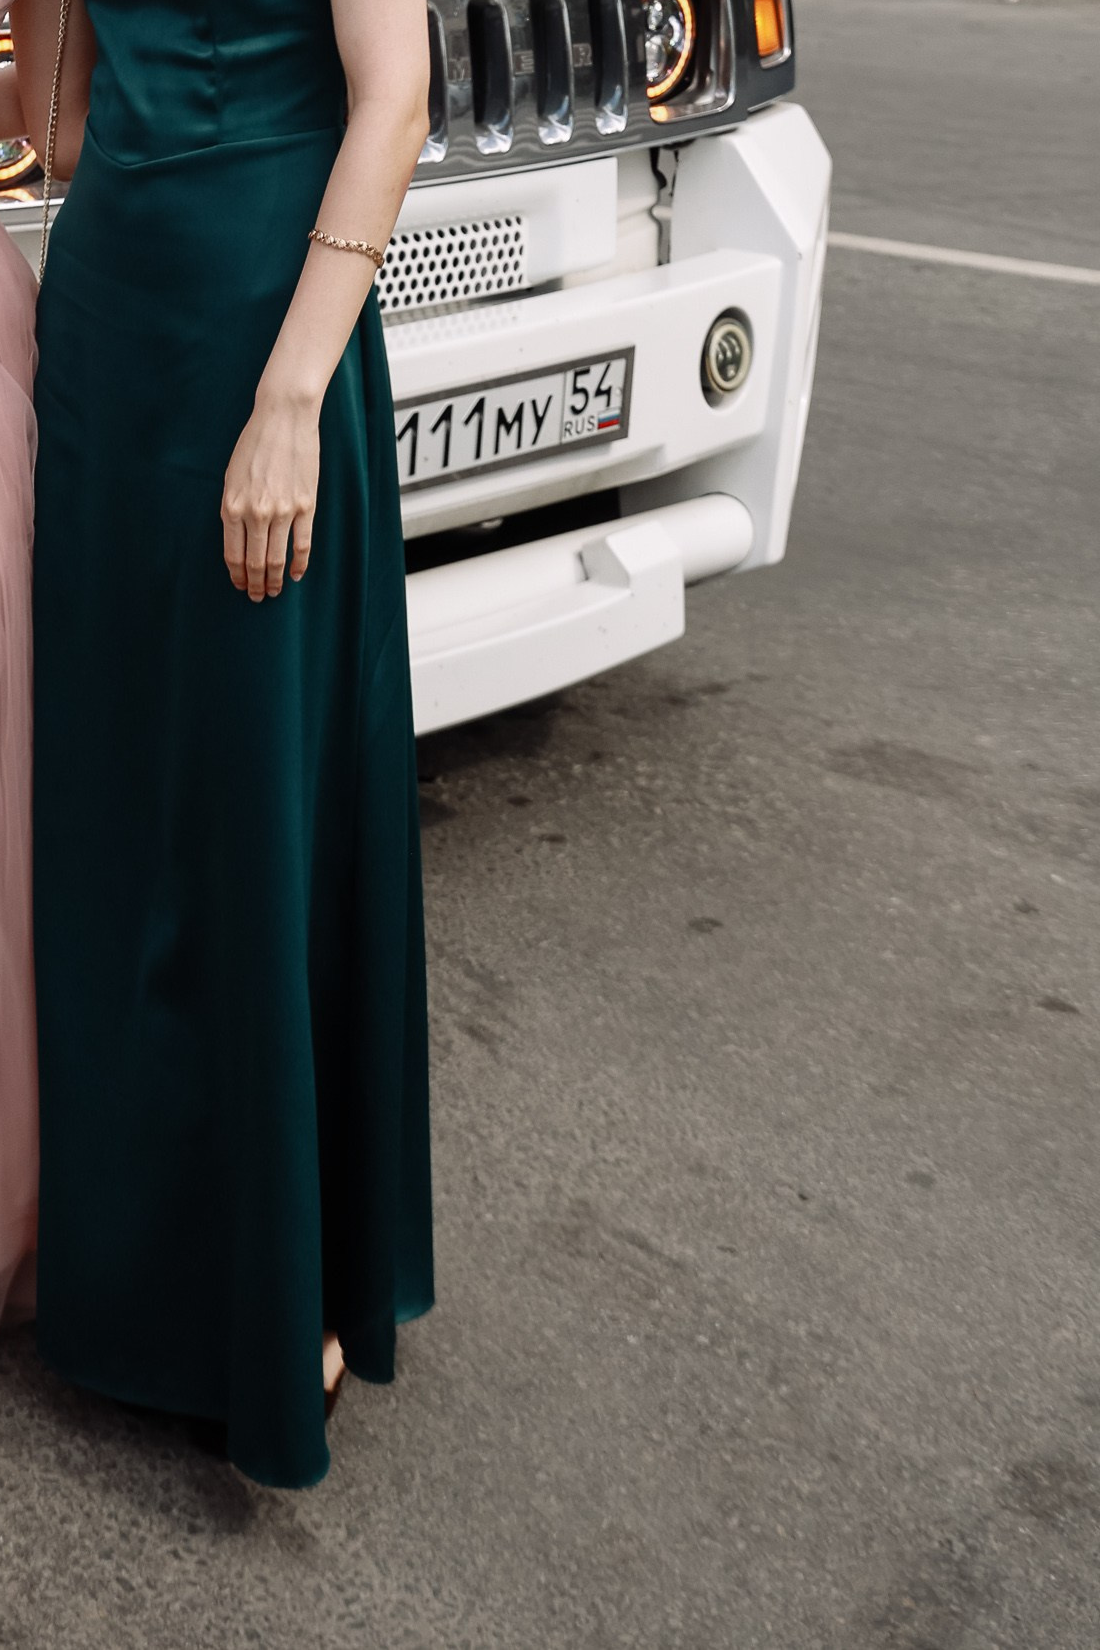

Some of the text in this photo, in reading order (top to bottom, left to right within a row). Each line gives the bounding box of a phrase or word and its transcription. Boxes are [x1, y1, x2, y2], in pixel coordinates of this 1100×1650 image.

[447, 43, 593, 82] MER
[570, 362, 613, 415] 54
[396, 395, 553, 476] 111МУ
[564, 416, 596, 438] RUS
